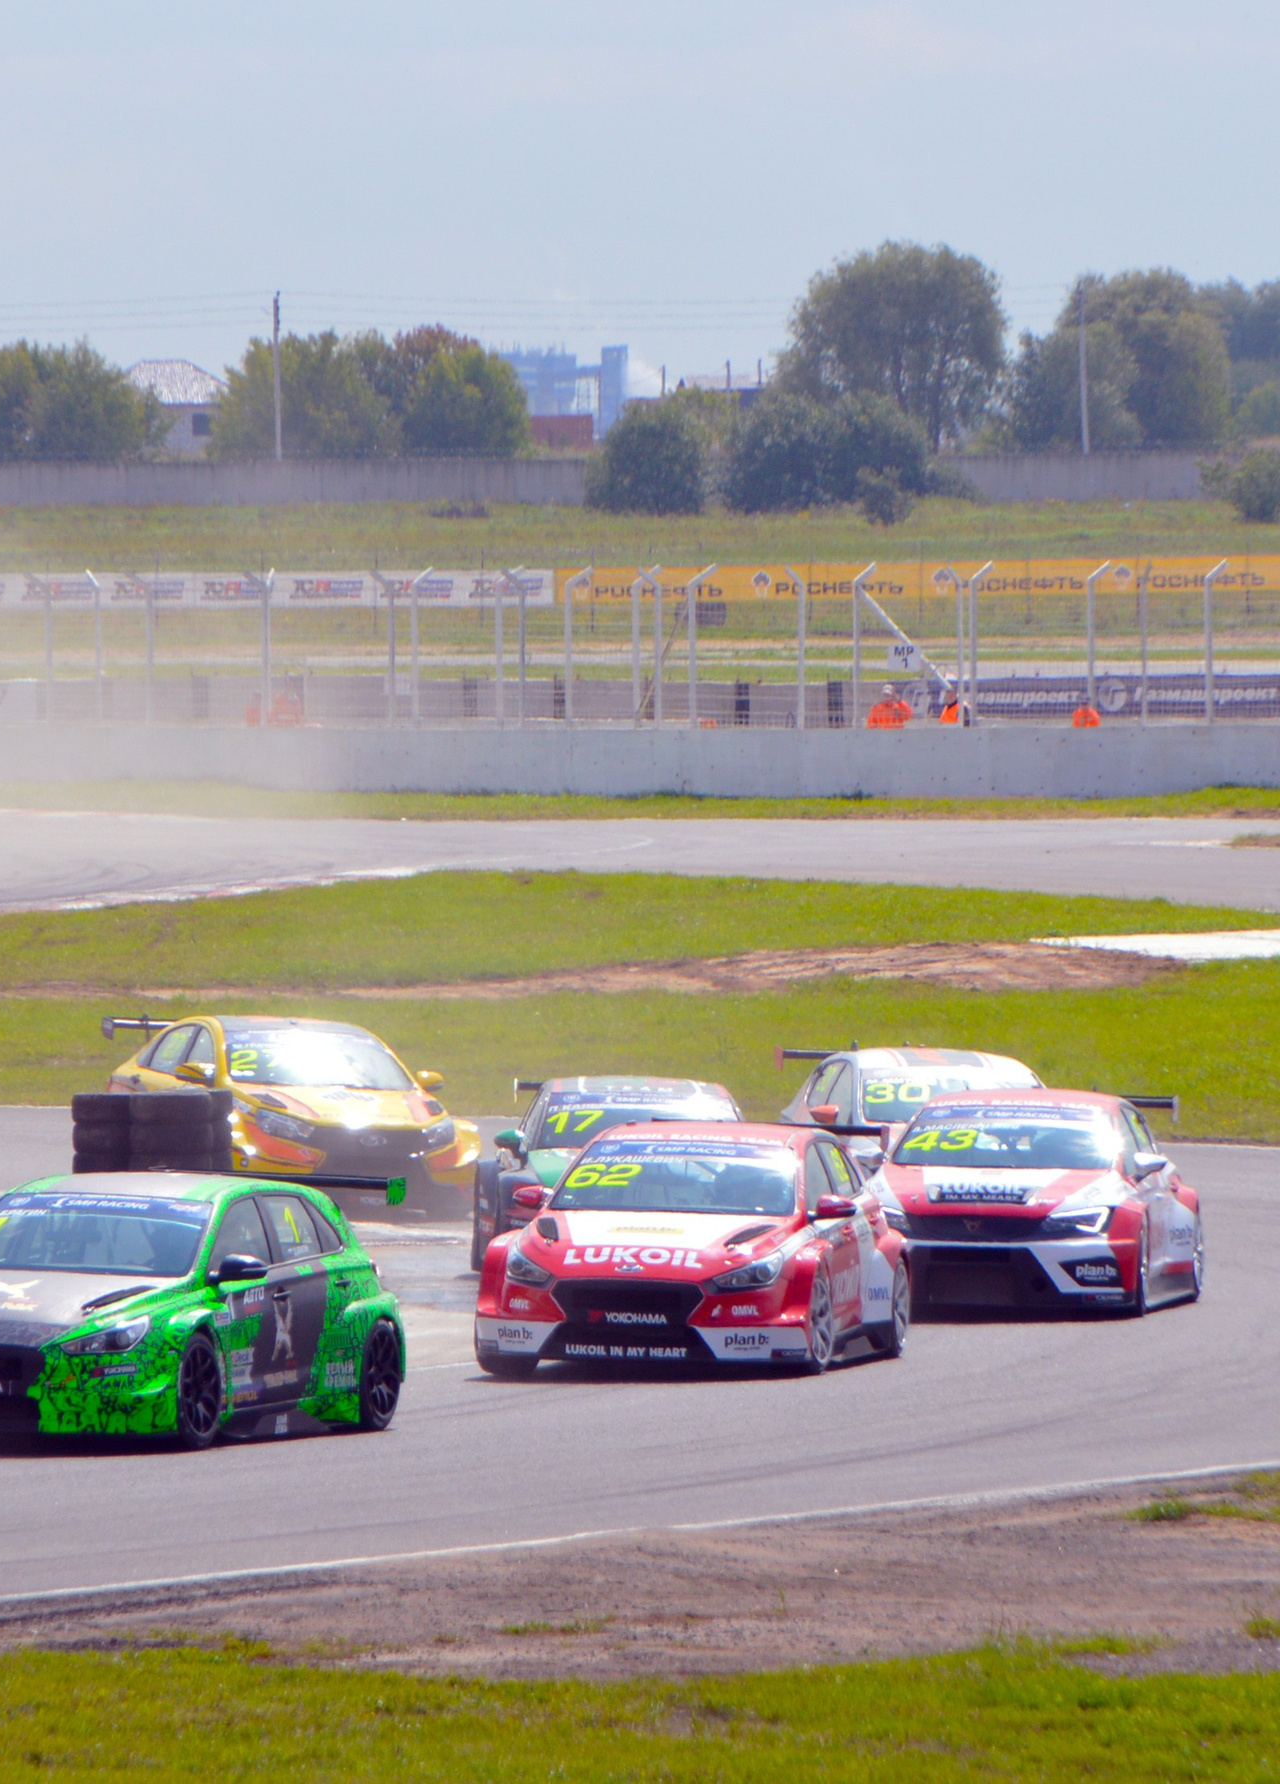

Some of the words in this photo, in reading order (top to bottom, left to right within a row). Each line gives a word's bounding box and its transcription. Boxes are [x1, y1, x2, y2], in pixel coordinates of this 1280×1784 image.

[1137, 572, 1266, 588] РОСНФТЬ
[865, 1083, 931, 1103] 30
[547, 1110, 604, 1133] 17
[903, 1129, 978, 1151] 43
[565, 1164, 642, 1189] 62
[66, 1199, 96, 1207] SMP
[97, 1200, 150, 1210] RACING
[284, 1207, 301, 1243] 1
[563, 1246, 703, 1269] LUKOIL
[867, 1286, 890, 1300] OMVL
[731, 1304, 759, 1316] OMVL
[605, 1312, 667, 1325] YOKOHAMA
[497, 1326, 520, 1340] plan
[724, 1333, 756, 1348] plan
[565, 1344, 606, 1356] LUKOIL
[610, 1345, 623, 1356] IN
[626, 1346, 645, 1357] MY
[649, 1346, 687, 1358] HEART
